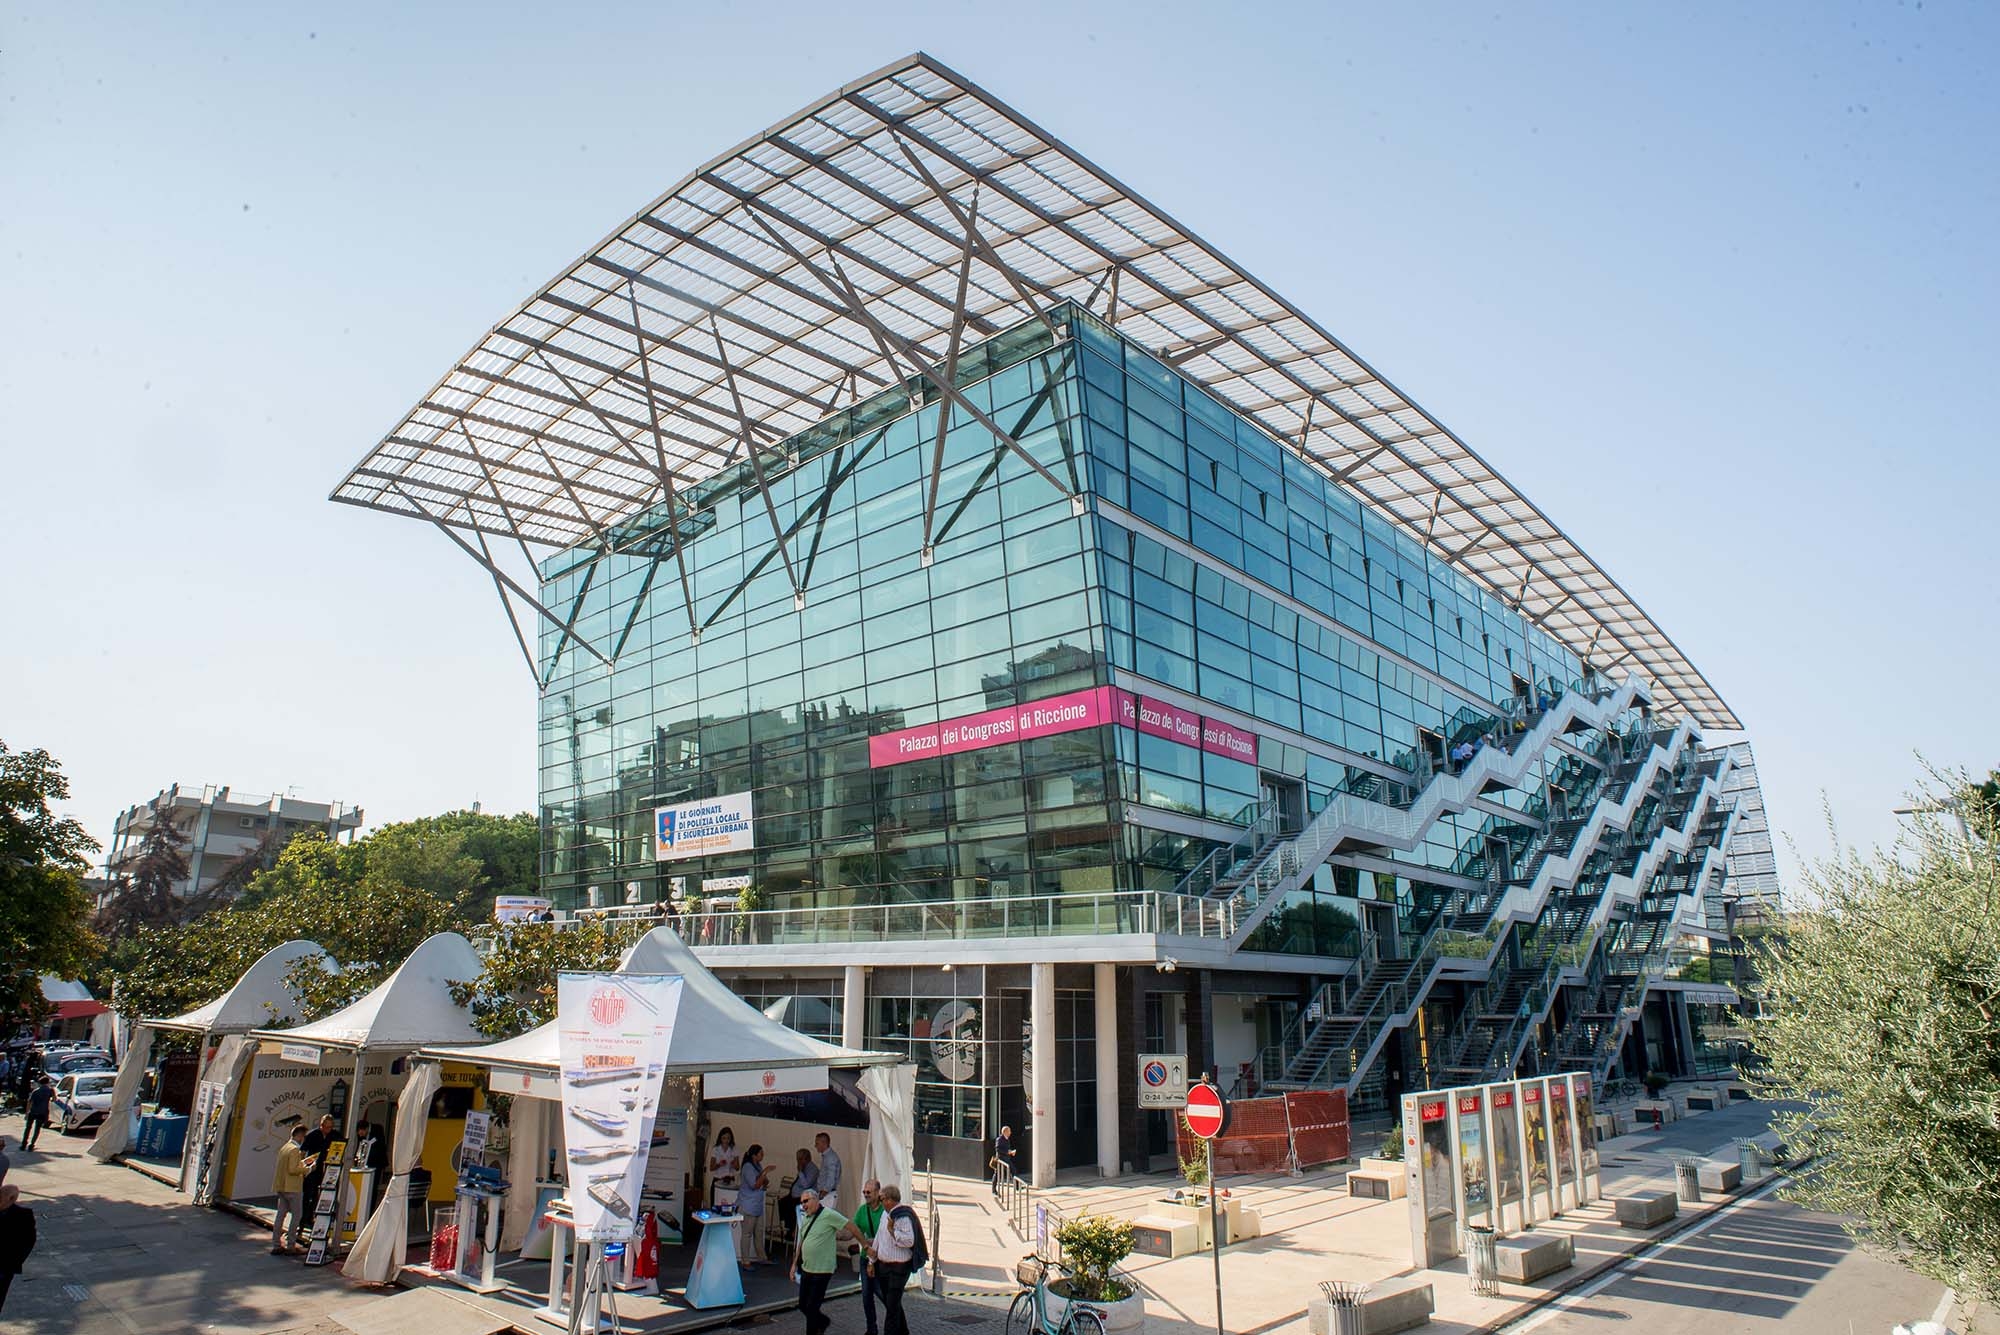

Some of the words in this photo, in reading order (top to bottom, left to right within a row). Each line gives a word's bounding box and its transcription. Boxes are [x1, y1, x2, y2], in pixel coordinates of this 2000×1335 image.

[899, 735, 938, 753] Palazzo
[942, 729, 958, 745] dei
[961, 716, 1015, 741] Congressi
[1020, 714, 1031, 730] di
[1034, 704, 1087, 725] Riccione
[1123, 700, 1160, 726] Palazzo
[1175, 717, 1218, 744] Congressi
[679, 821, 686, 829] DI
[687, 817, 713, 828] POLIZIA
[716, 812, 740, 823] LOCALE
[680, 811, 687, 819] LE
[689, 805, 722, 818] GIORNATE
[677, 832, 682, 840] E
[683, 826, 719, 839] SICUREZZA
[720, 822, 748, 834] URBANA
[626, 882, 640, 904] 2
[670, 877, 683, 899] 3
[258, 1068, 297, 1079] DEPOSITO
[299, 1067, 320, 1078] ARMI
[265, 1105, 273, 1114] A
[272, 1090, 306, 1109] NORMA
[1424, 1103, 1439, 1117] OGGI
[1461, 1097, 1475, 1111] OGGI
